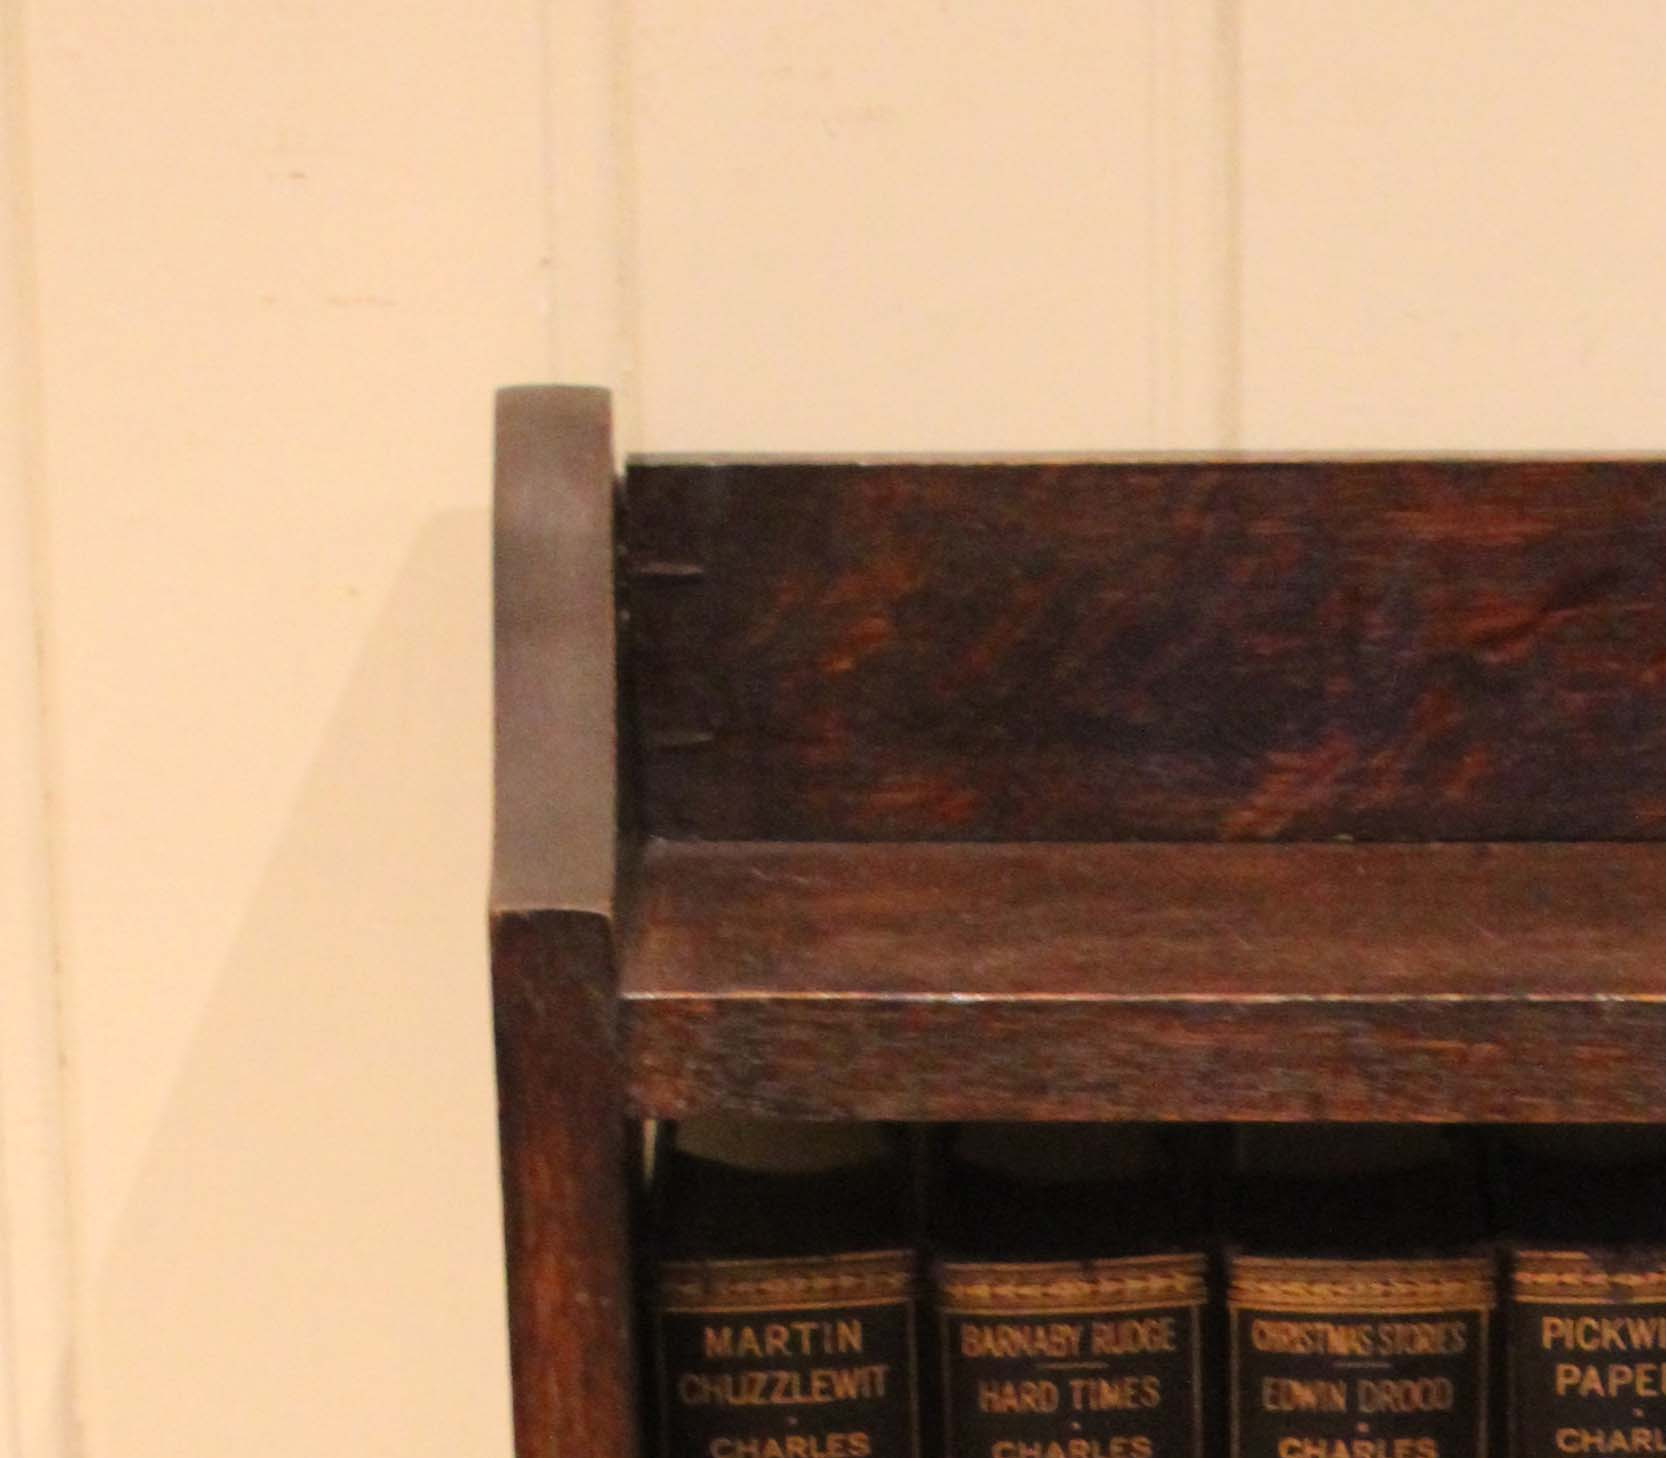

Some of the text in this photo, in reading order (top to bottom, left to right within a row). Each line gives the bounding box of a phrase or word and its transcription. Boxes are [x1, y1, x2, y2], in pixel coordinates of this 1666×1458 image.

[705, 1320, 862, 1358] MARTIN
[961, 1318, 1176, 1358] BARNABY RUDGE
[1380, 1322, 1467, 1354] STORIES
[679, 1365, 888, 1406] CHUZZLEWIT
[979, 1376, 1161, 1412] HARD TIMES
[1263, 1378, 1453, 1412] EDWIN DROOD
